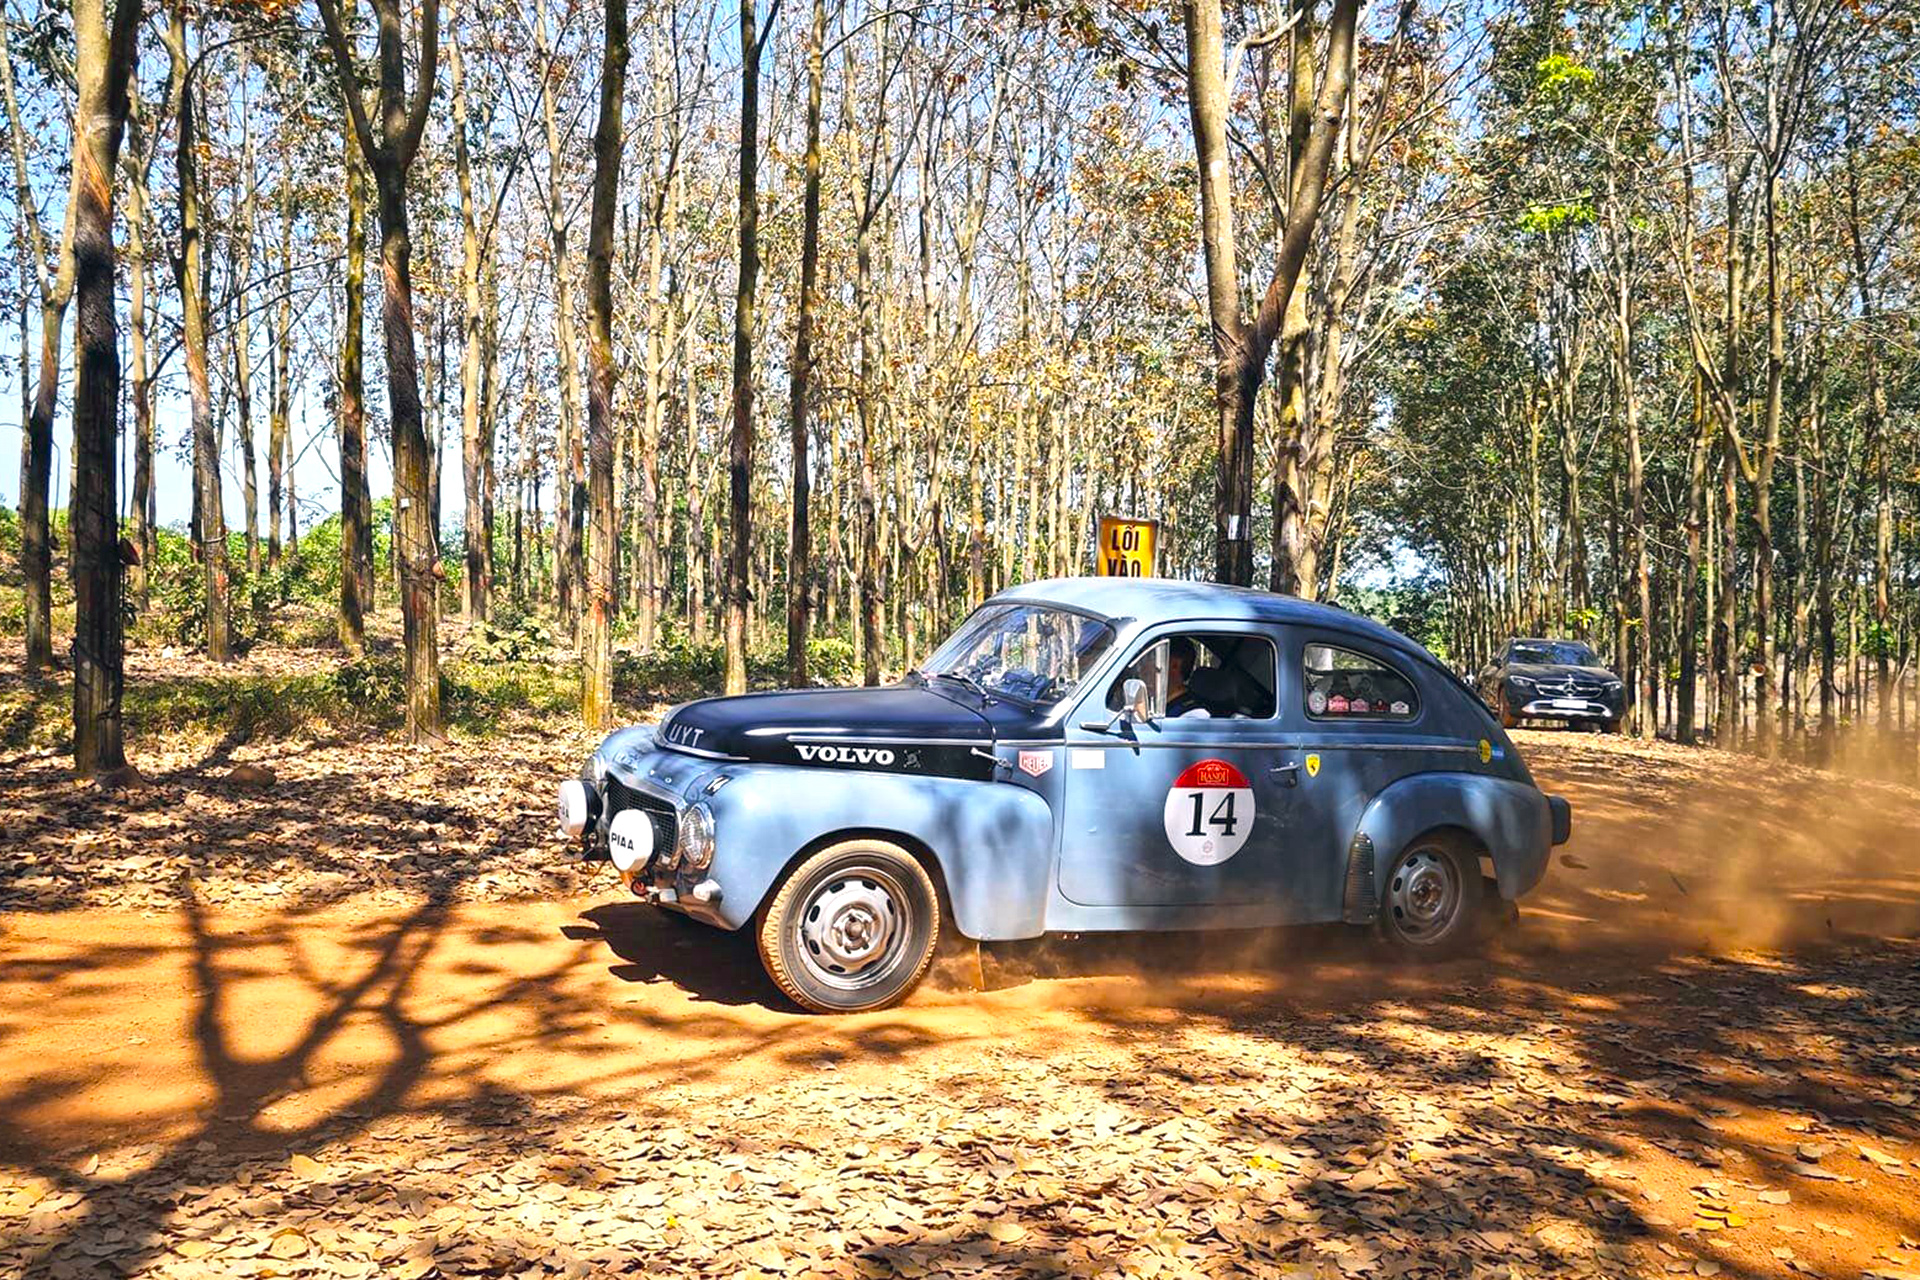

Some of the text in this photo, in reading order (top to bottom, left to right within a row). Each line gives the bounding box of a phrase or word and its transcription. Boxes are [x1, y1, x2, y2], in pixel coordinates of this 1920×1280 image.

[1111, 524, 1140, 551] LỐI
[668, 723, 704, 748] UYT
[794, 745, 895, 765] VOLVO
[1185, 792, 1237, 836] 14
[610, 832, 635, 851] PIAA
